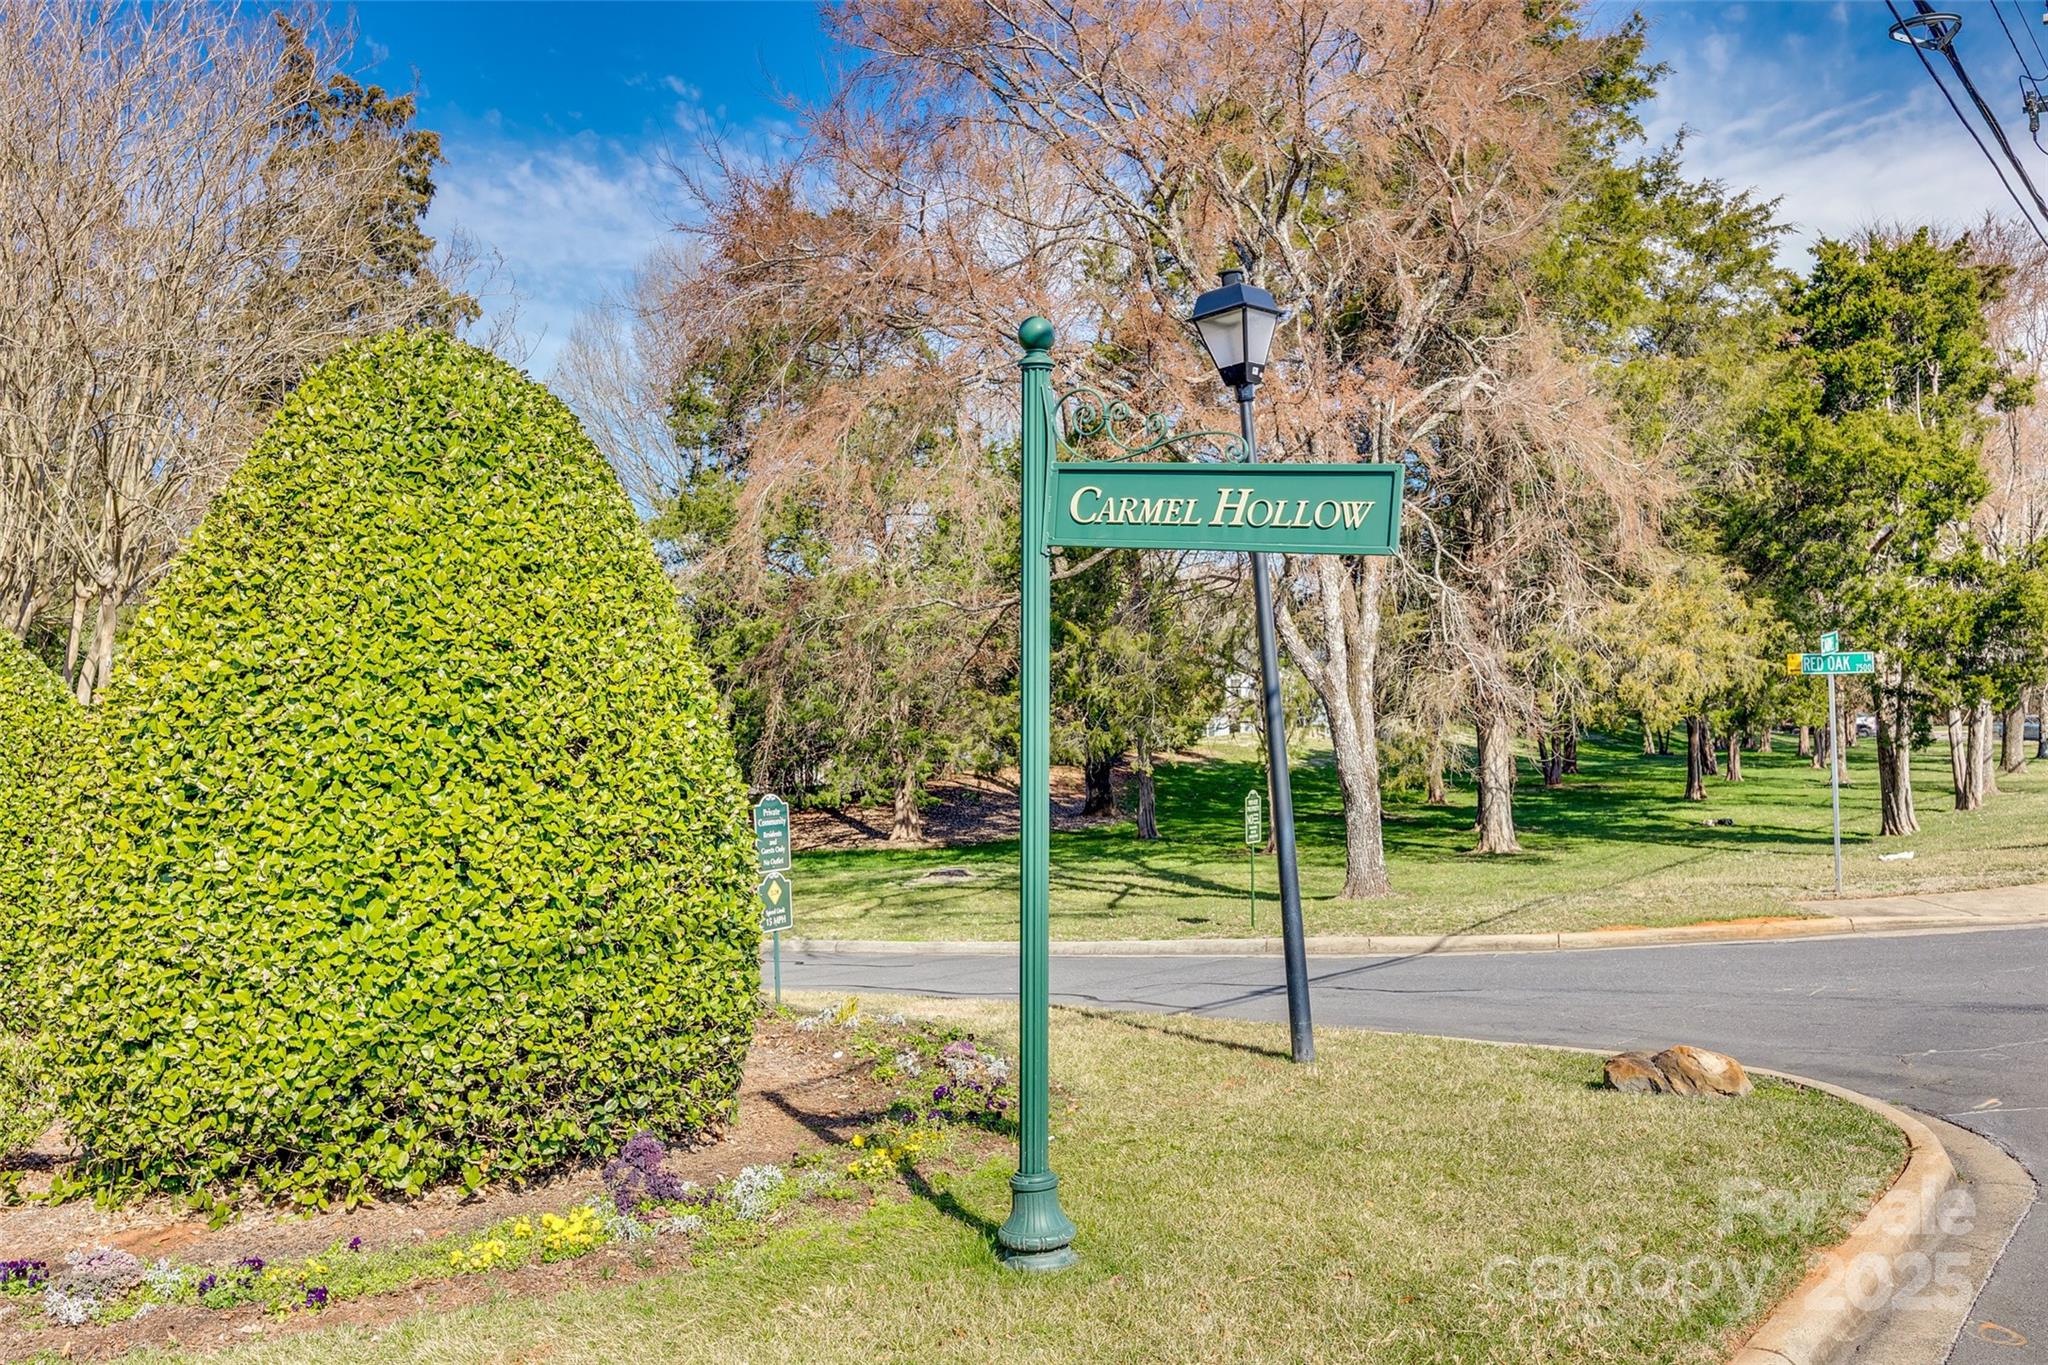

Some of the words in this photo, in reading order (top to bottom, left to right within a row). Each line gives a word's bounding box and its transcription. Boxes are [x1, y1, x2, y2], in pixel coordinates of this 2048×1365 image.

[1069, 485, 1203, 525] CARMEL
[1208, 487, 1376, 530] HOLLOW
[1803, 657, 1824, 671] RED
[1827, 655, 1851, 671] OAK
[1856, 664, 1873, 672] 7500
[763, 808, 780, 817] Private
[757, 816, 786, 827] Community
[763, 831, 782, 839] Residents
[769, 838, 778, 846] and
[775, 845, 785, 855] Only
[770, 857, 784, 865] Outlet
[766, 918, 774, 927] 15
[774, 916, 786, 927] MPH
